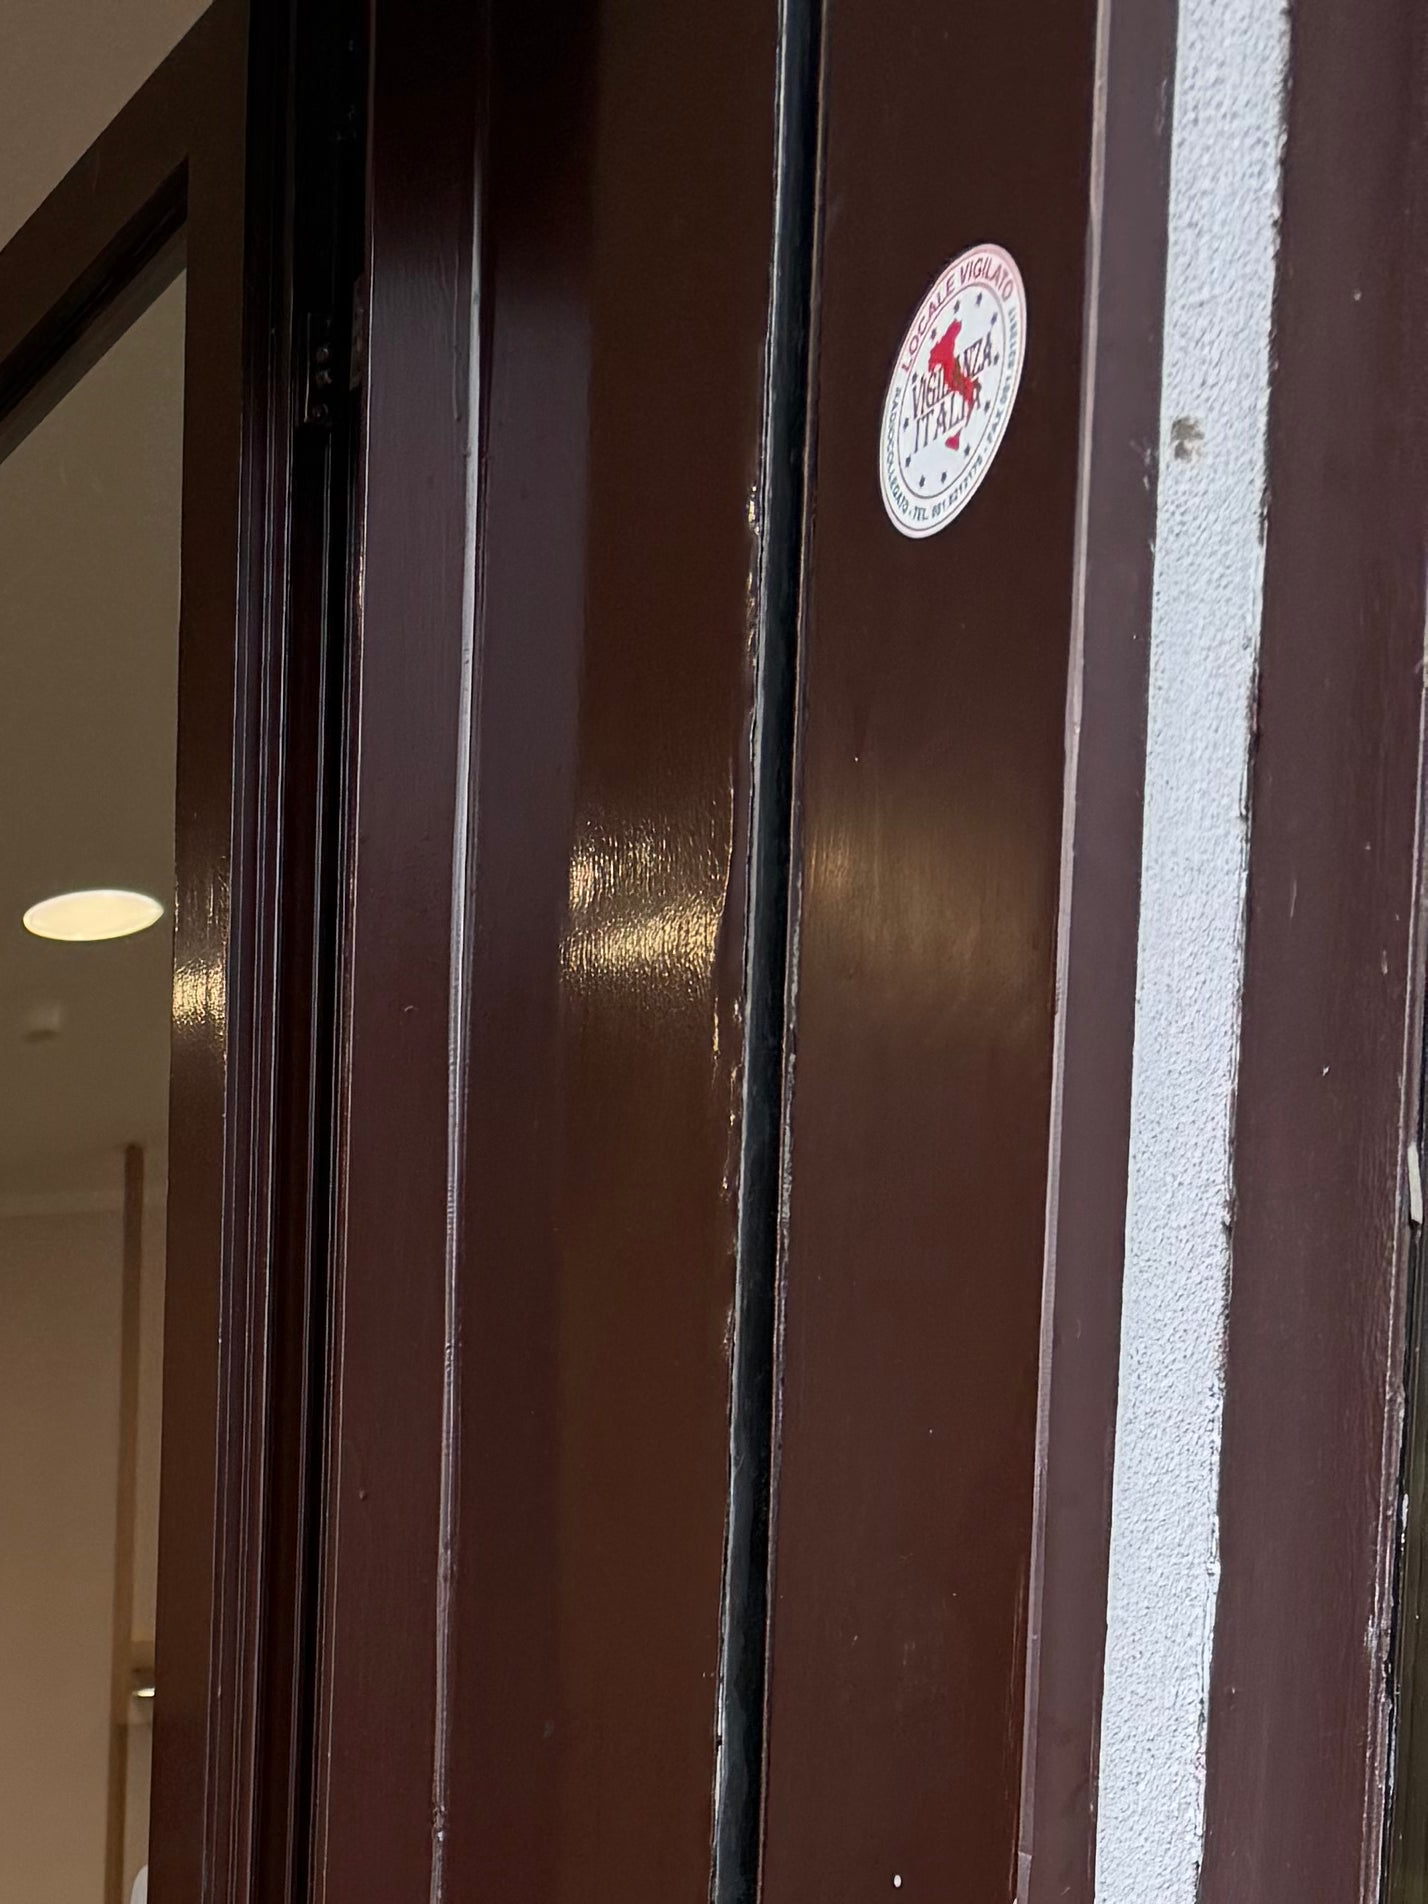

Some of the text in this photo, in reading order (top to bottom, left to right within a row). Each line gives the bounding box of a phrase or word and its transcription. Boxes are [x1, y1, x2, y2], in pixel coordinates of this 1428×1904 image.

[901, 255, 1014, 373] LOCALE VIGILATO
[914, 378, 981, 454] ITALIA
